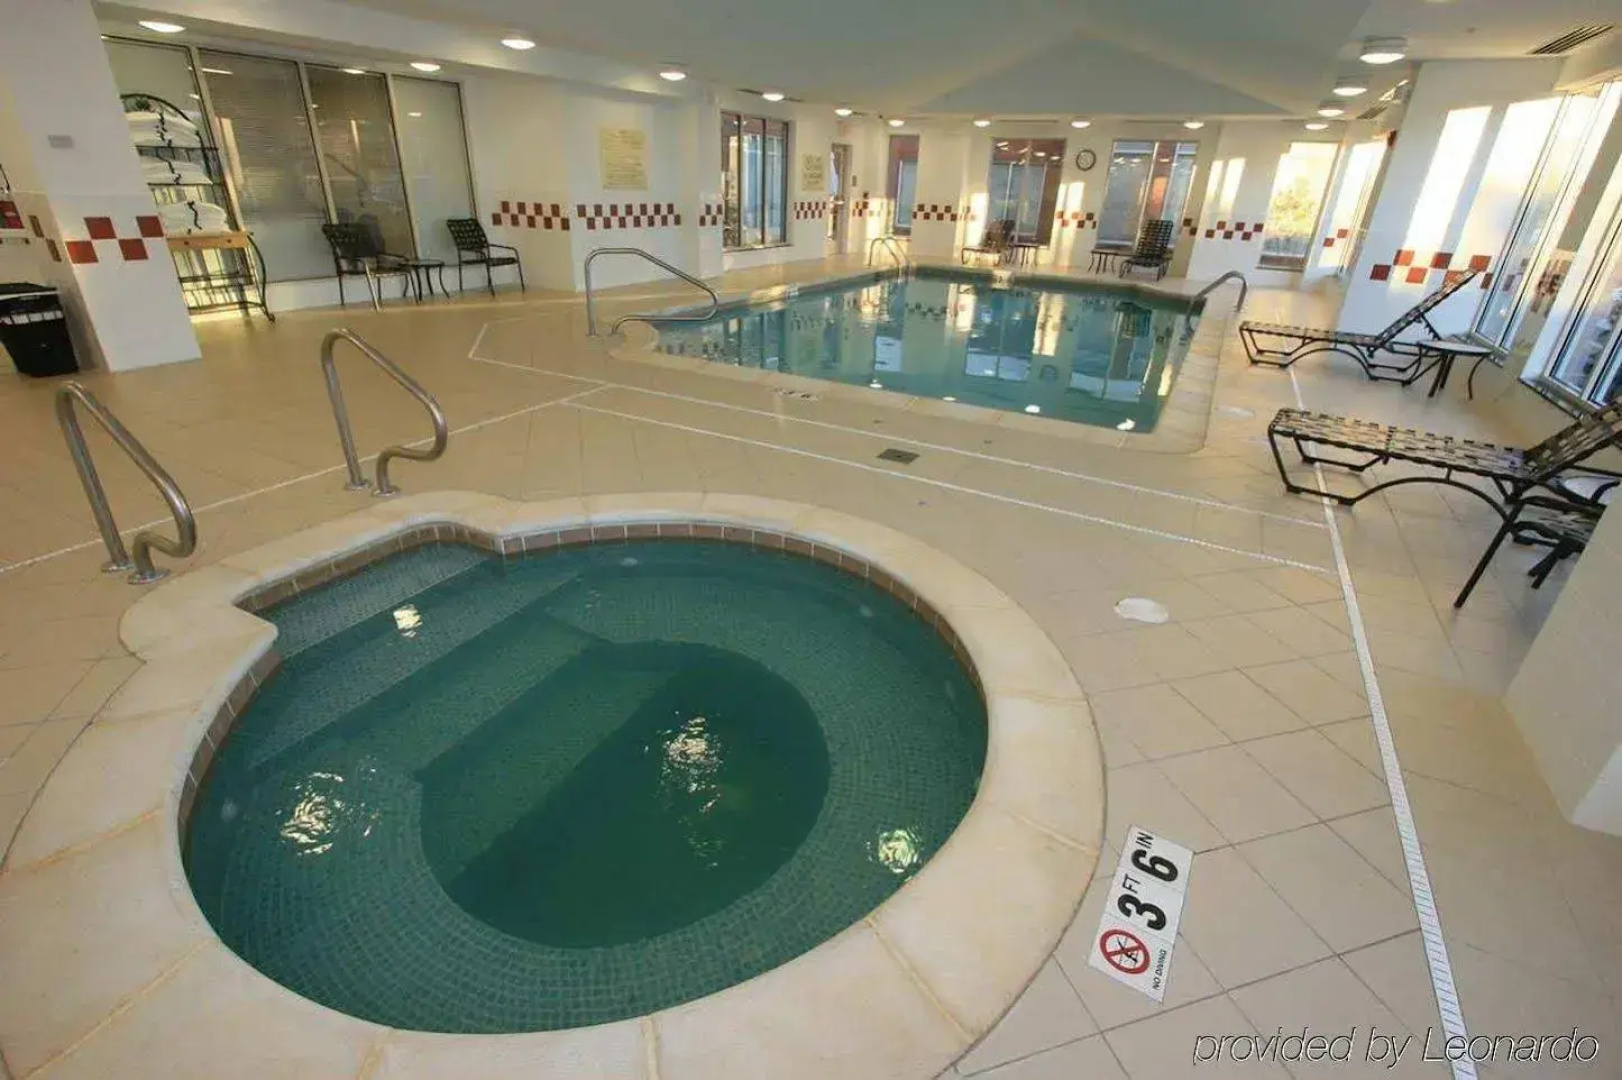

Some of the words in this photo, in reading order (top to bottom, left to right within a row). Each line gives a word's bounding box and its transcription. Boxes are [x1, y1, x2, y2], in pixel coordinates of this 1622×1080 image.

[1135, 831, 1154, 849] IN
[1131, 849, 1179, 882] 6
[1121, 873, 1141, 894] FT
[1117, 893, 1167, 931] 3
[1155, 949, 1167, 976] DIVING
[1152, 977, 1161, 990] NO
